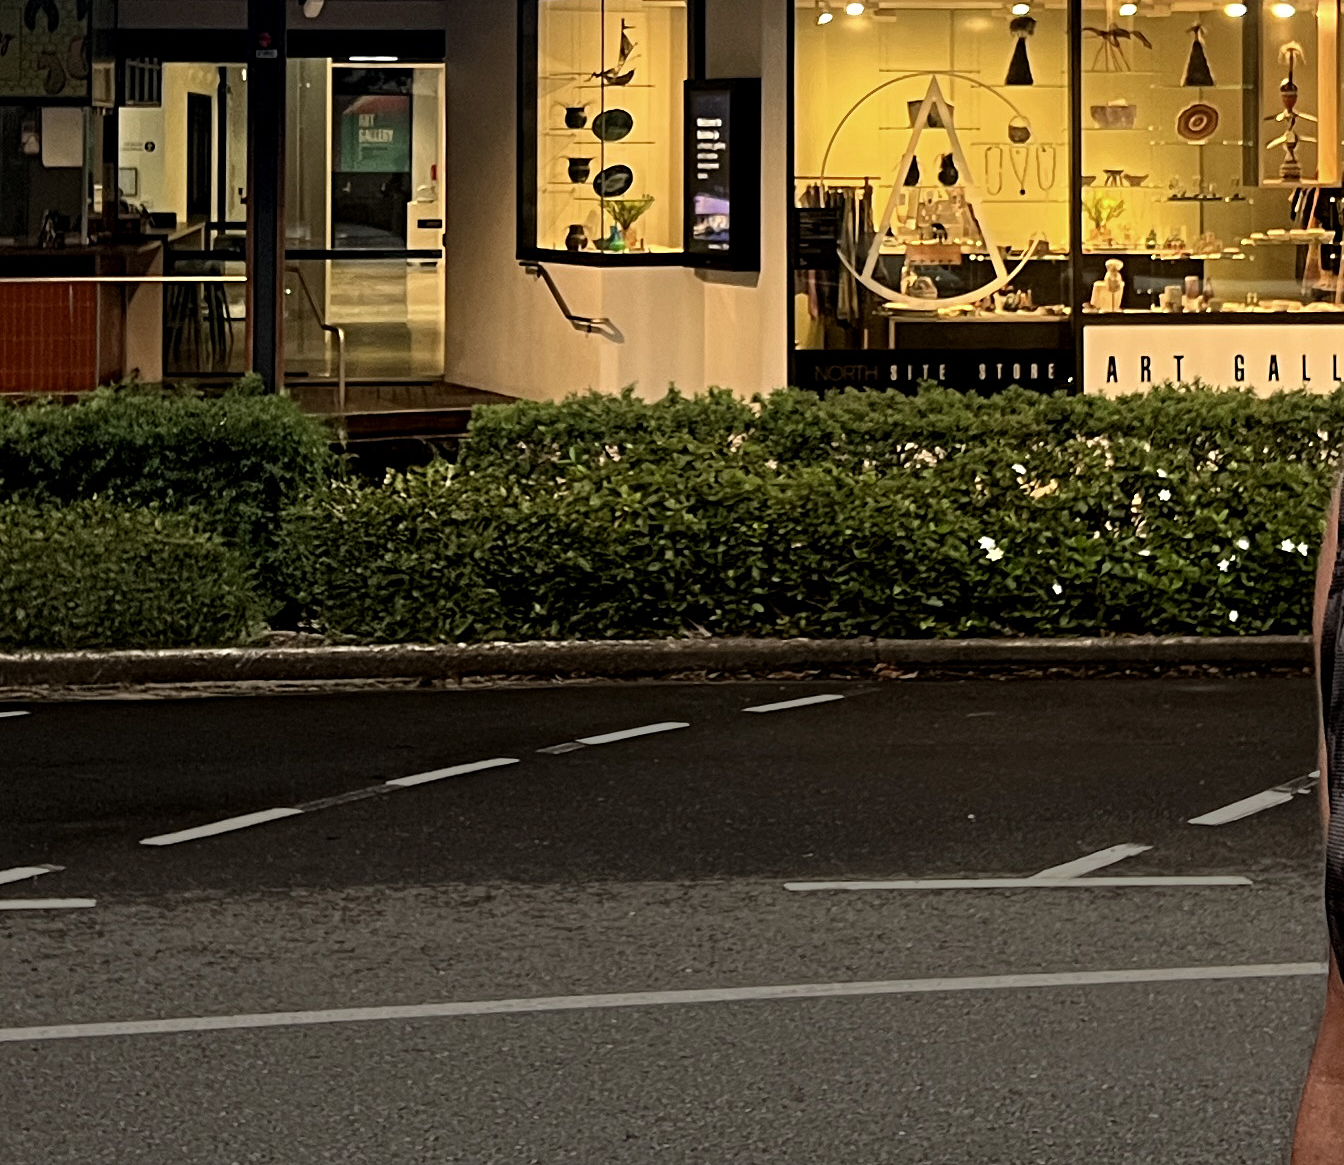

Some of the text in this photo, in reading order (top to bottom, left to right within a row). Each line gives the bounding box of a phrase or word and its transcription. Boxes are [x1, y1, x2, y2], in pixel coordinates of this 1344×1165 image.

[814, 363, 1055, 382] NORTH SITE STORE
[1106, 354, 1185, 383] ART
